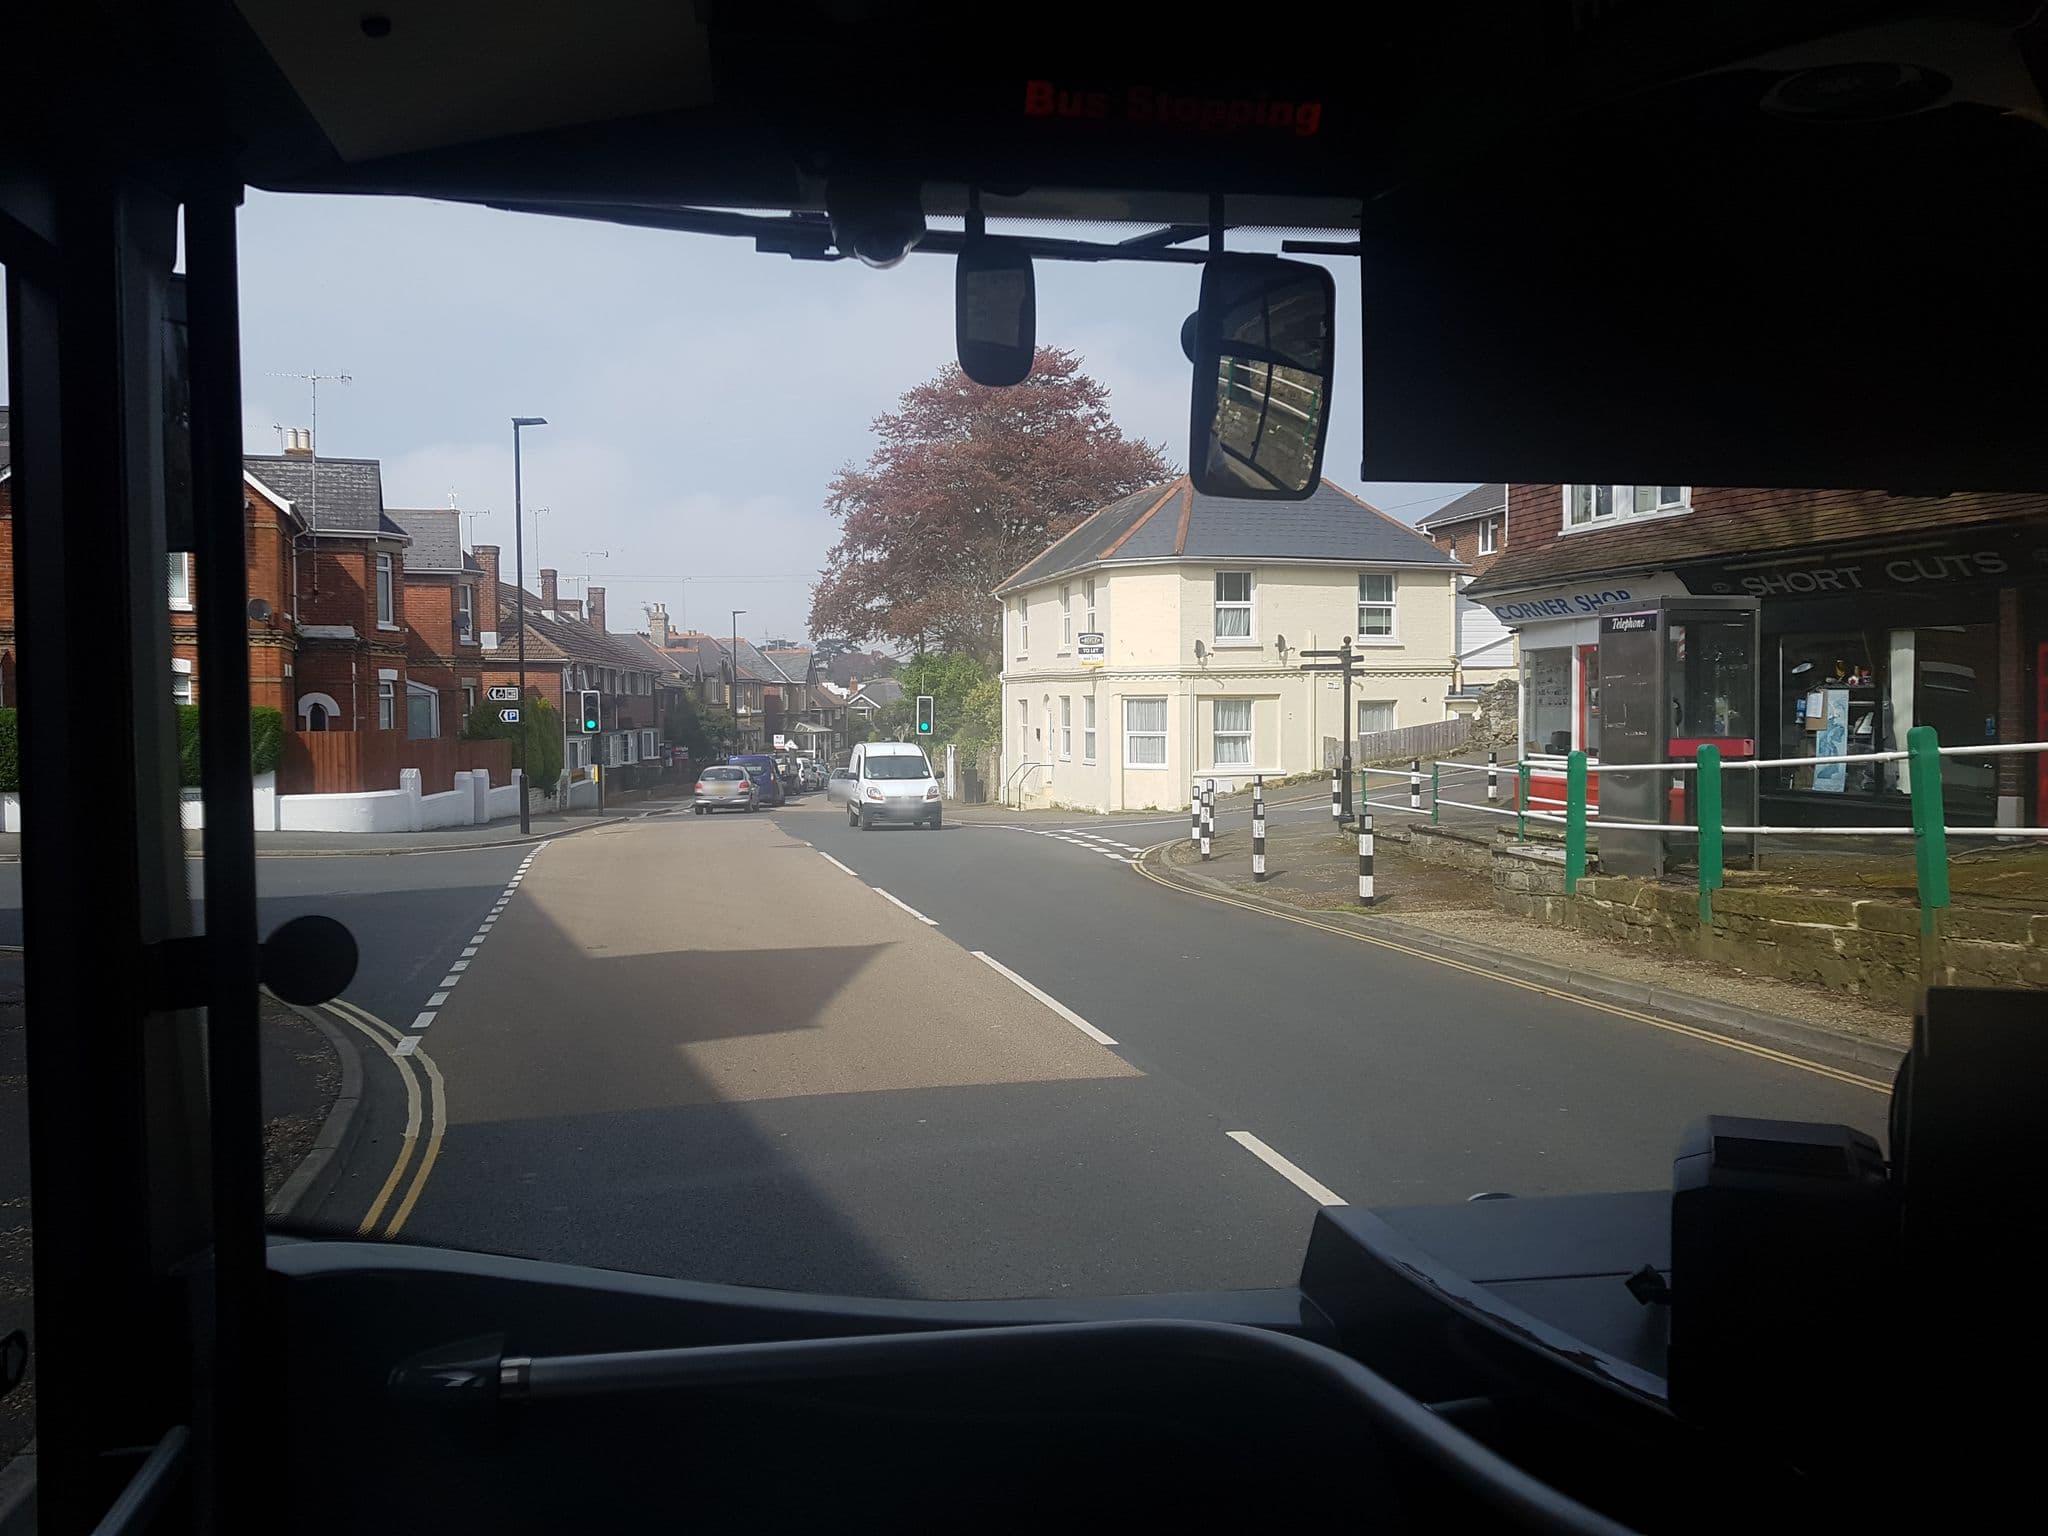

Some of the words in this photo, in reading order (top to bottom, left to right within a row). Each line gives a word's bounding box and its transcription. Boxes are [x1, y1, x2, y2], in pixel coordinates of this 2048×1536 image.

[1024, 79, 1112, 119] Bus
[1126, 83, 1323, 137] Stopping
[1741, 565, 1865, 597] SHORT
[1886, 551, 2009, 583] CUTS
[1494, 598, 1574, 621] CORNER
[1611, 617, 1646, 632] Telephone
